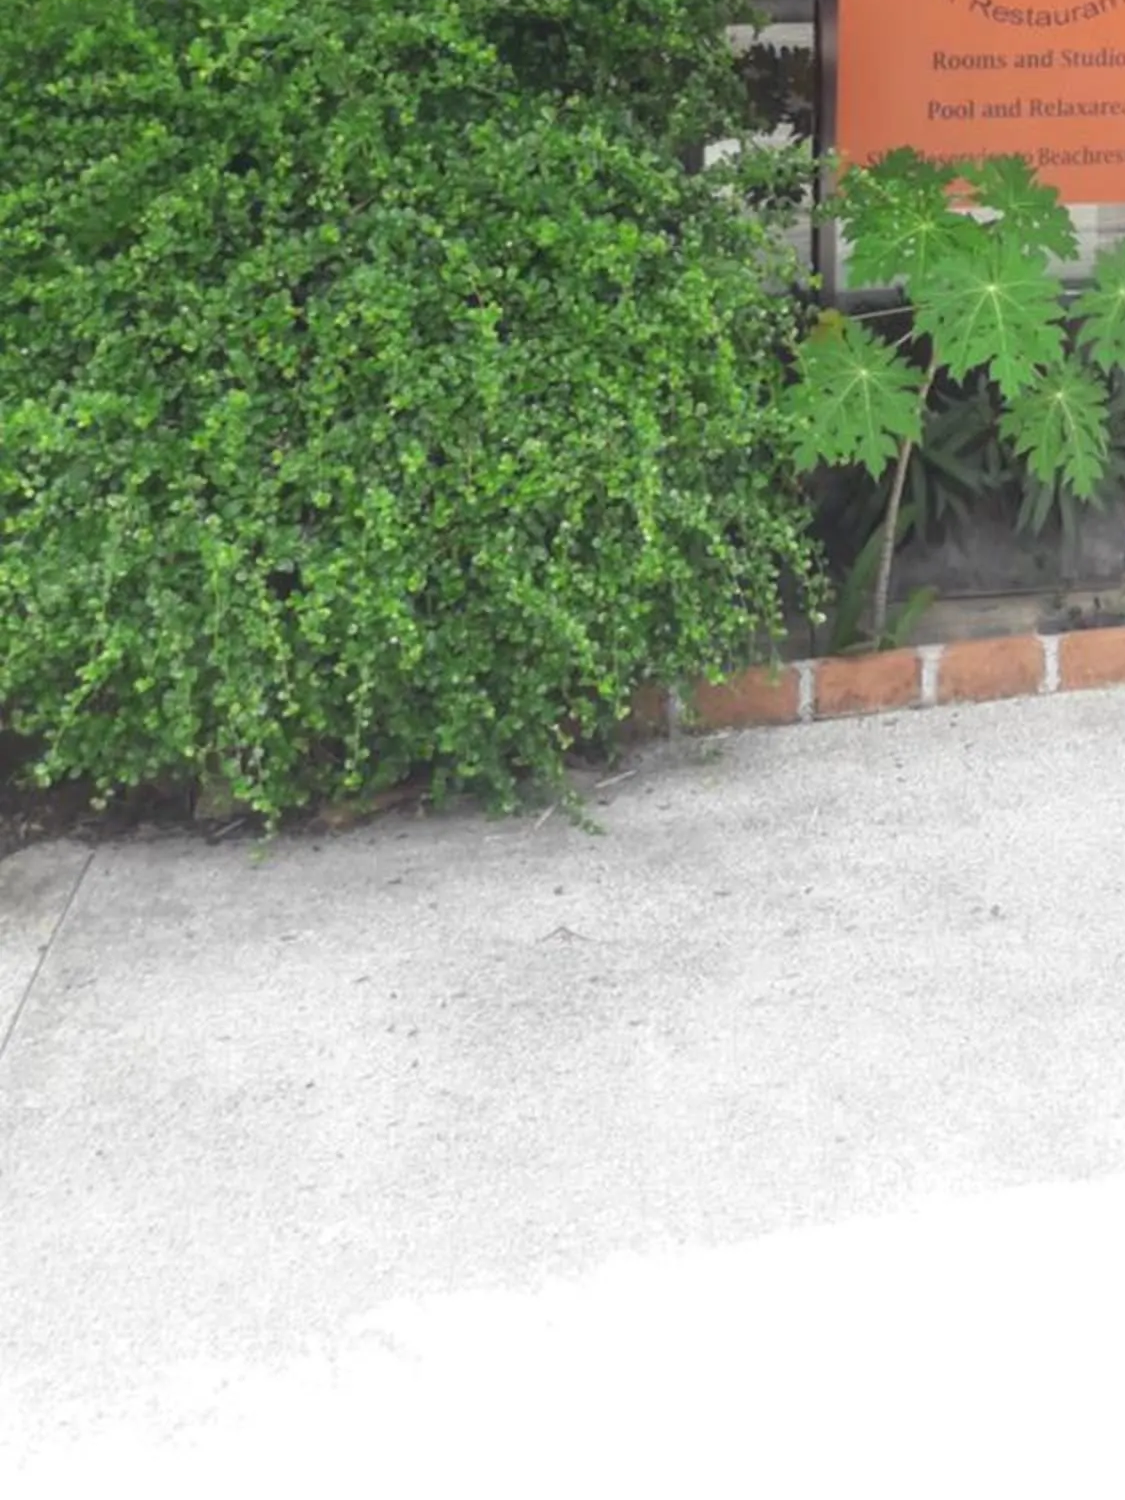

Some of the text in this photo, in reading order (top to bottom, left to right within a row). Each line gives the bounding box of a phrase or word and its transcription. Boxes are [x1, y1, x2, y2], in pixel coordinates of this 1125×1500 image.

[932, 50, 1007, 71] Rooms
[1013, 49, 1053, 69] and
[927, 99, 975, 121] Pool
[981, 97, 1022, 119] and
